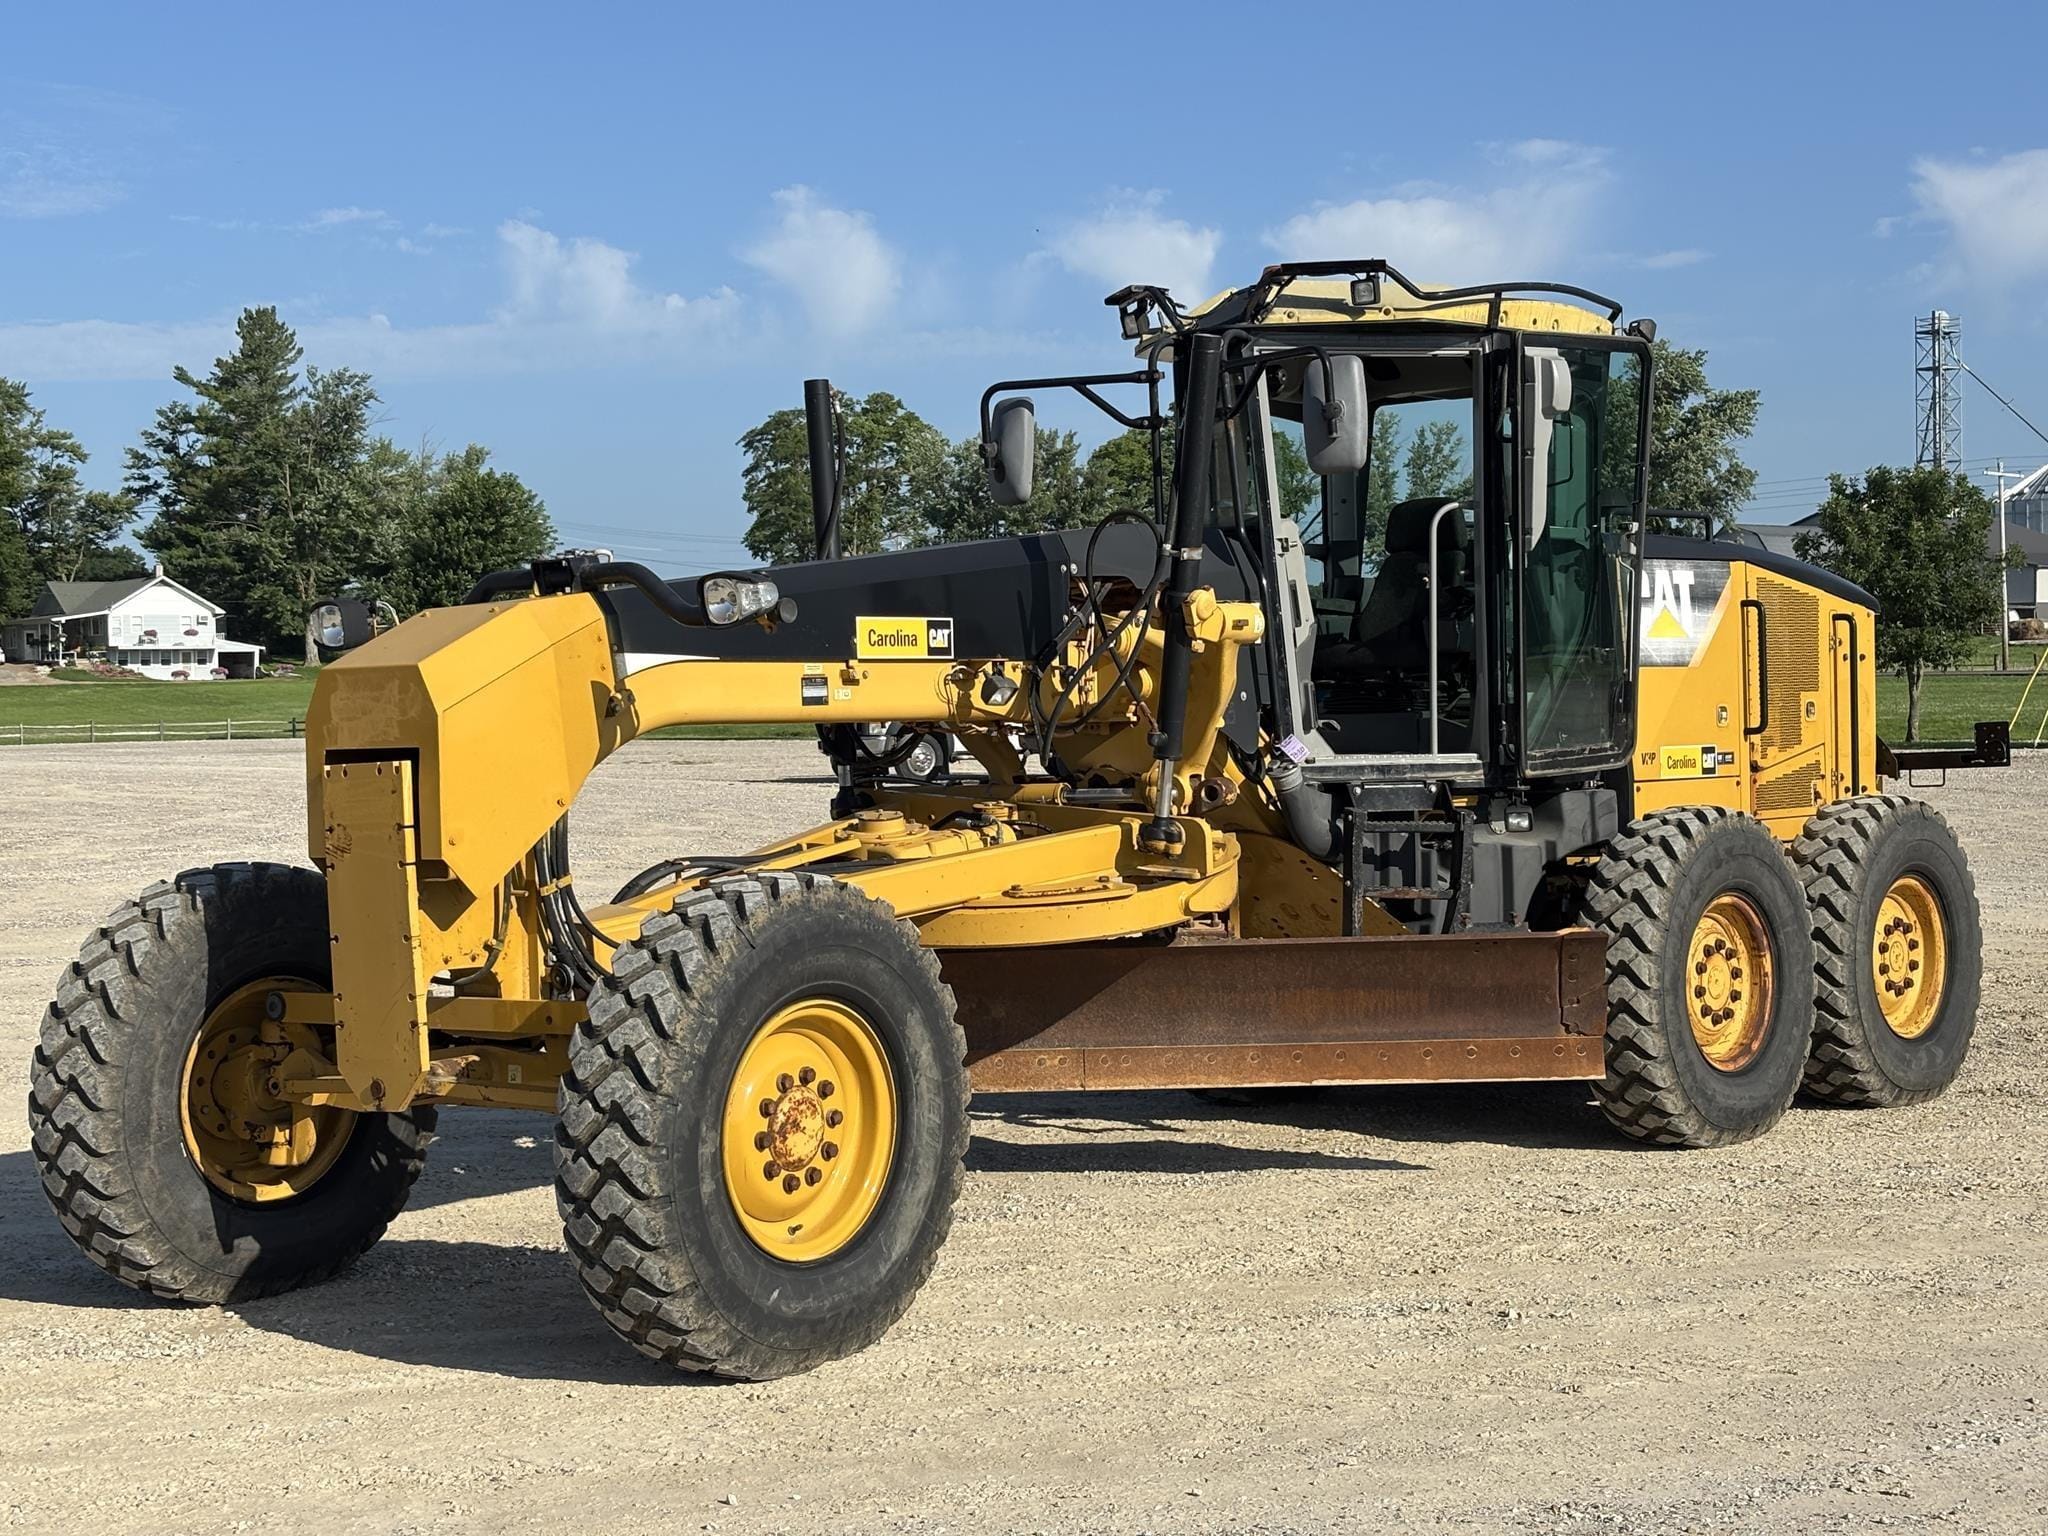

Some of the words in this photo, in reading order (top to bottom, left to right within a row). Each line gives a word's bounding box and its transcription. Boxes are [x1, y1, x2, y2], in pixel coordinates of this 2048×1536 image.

[868, 629, 918, 647] Carolina
[929, 629, 951, 648] CAT
[1667, 755, 1697, 769] Carolina
